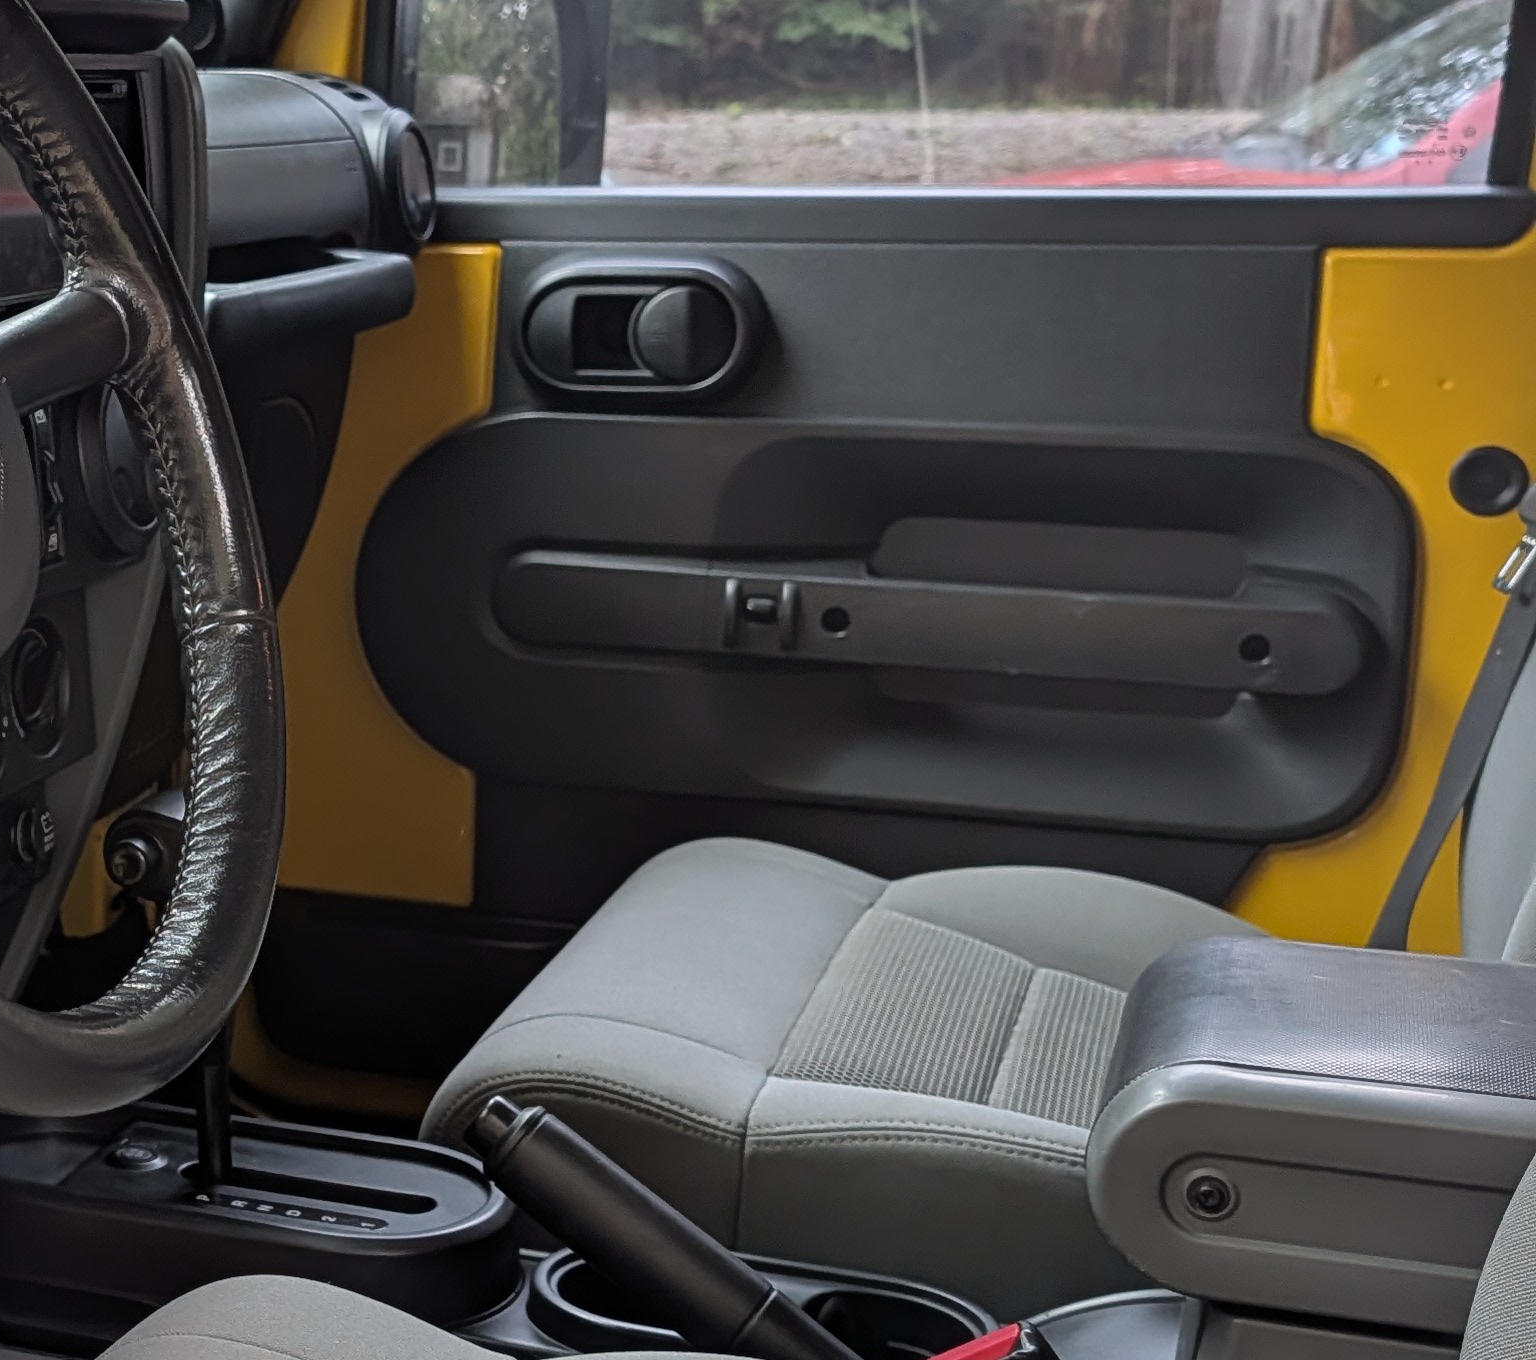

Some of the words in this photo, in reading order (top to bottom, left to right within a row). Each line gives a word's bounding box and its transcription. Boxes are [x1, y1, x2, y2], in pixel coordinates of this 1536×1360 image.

[195, 1194, 210, 1202] P
[230, 1199, 248, 1208] R
[256, 1204, 274, 1212] N
[285, 1209, 302, 1217] D
[321, 1215, 337, 1223] 2
